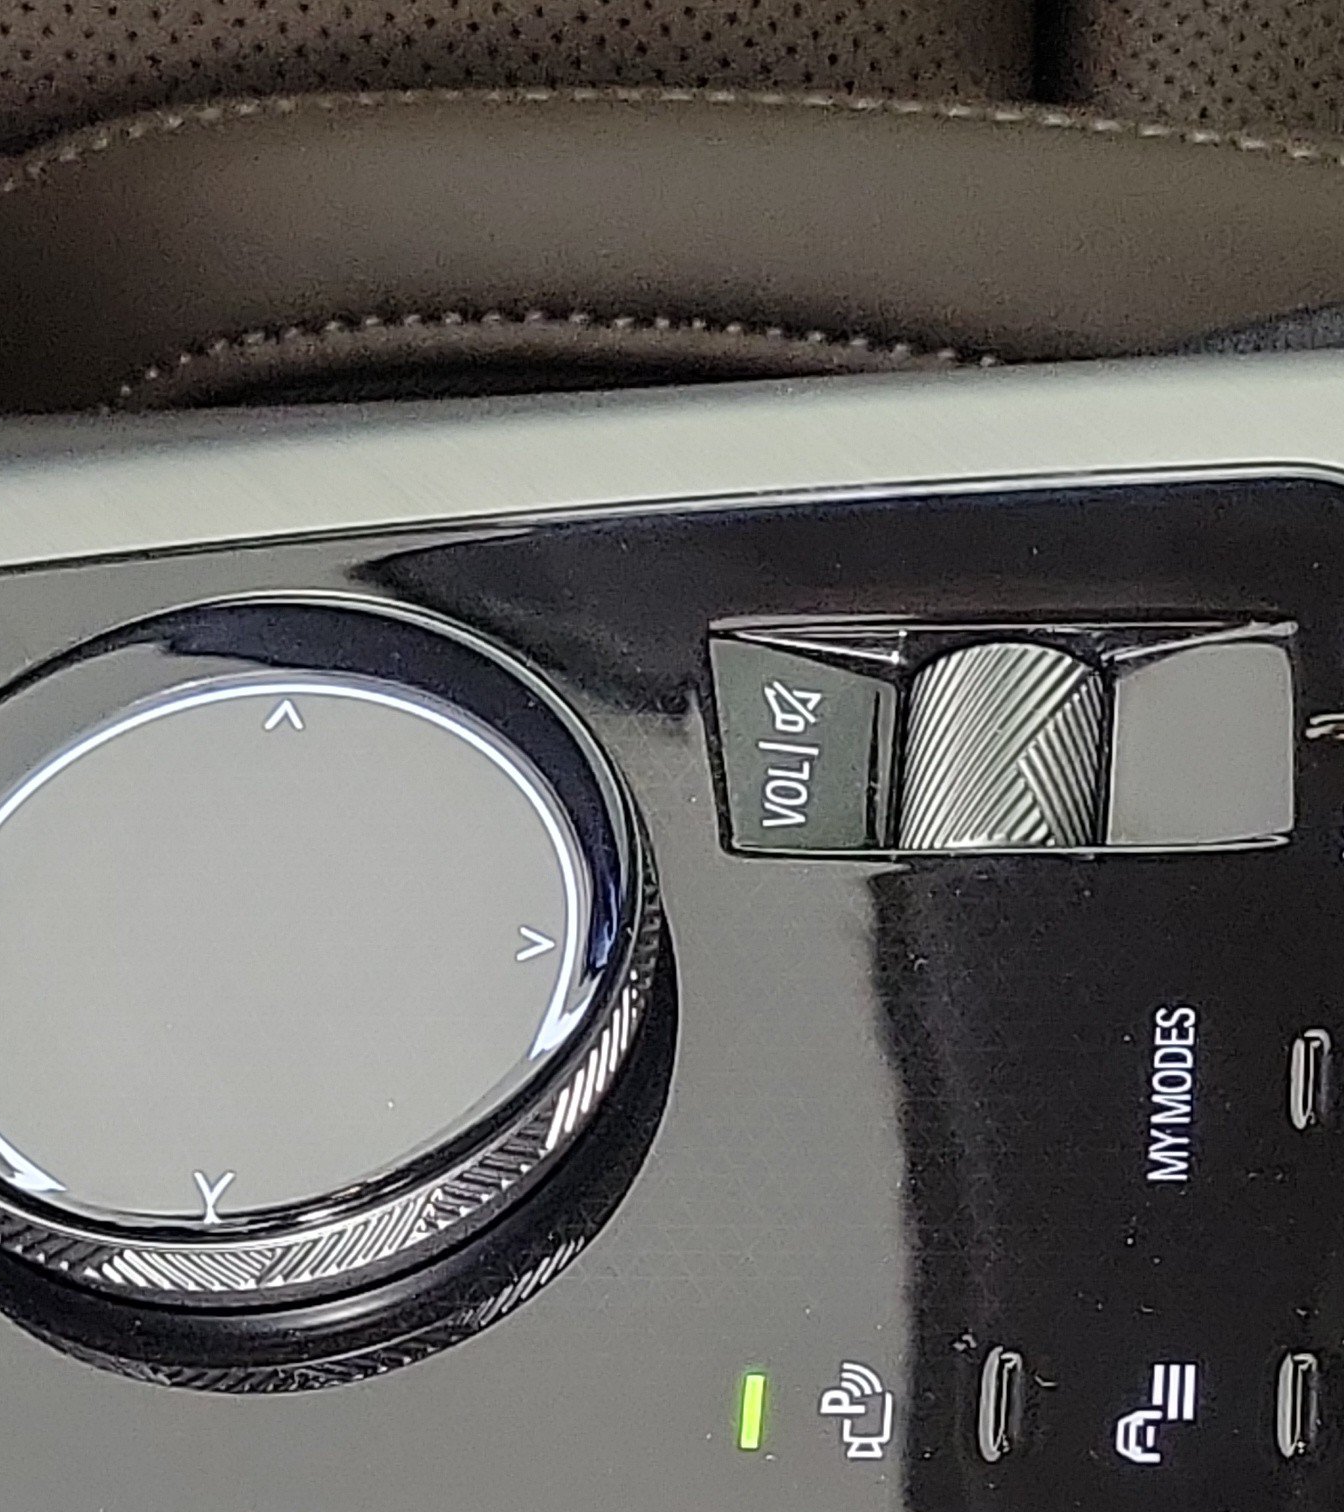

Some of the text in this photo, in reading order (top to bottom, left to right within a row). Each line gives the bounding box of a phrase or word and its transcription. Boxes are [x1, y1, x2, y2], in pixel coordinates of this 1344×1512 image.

[762, 761, 810, 827] VOL
[1146, 1007, 1196, 1180] MY MODES
